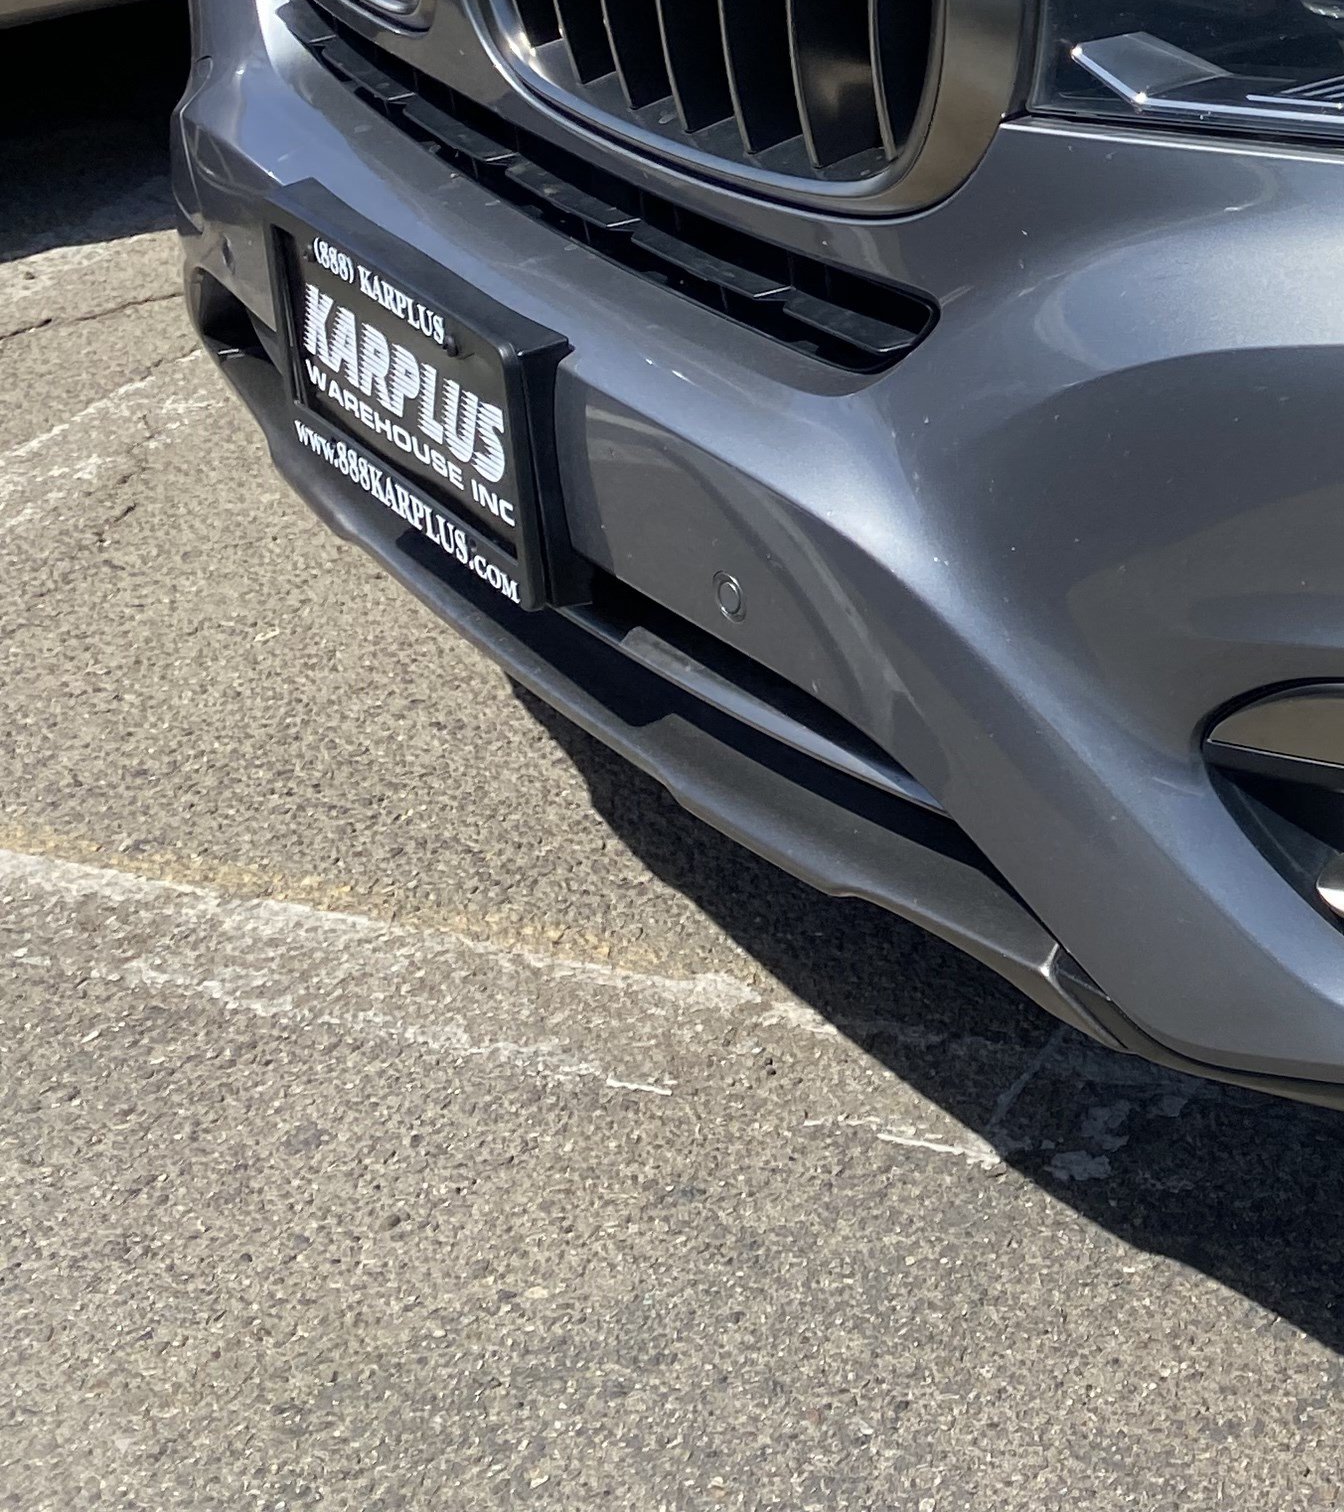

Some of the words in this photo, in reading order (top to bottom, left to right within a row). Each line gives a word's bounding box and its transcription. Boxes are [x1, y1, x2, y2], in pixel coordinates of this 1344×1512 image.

[312, 236, 354, 284] (888)
[357, 265, 446, 346] KARPLUS
[304, 283, 506, 483] KARPLUS
[304, 359, 465, 490] WAREHOUSE
[471, 478, 516, 528] INC
